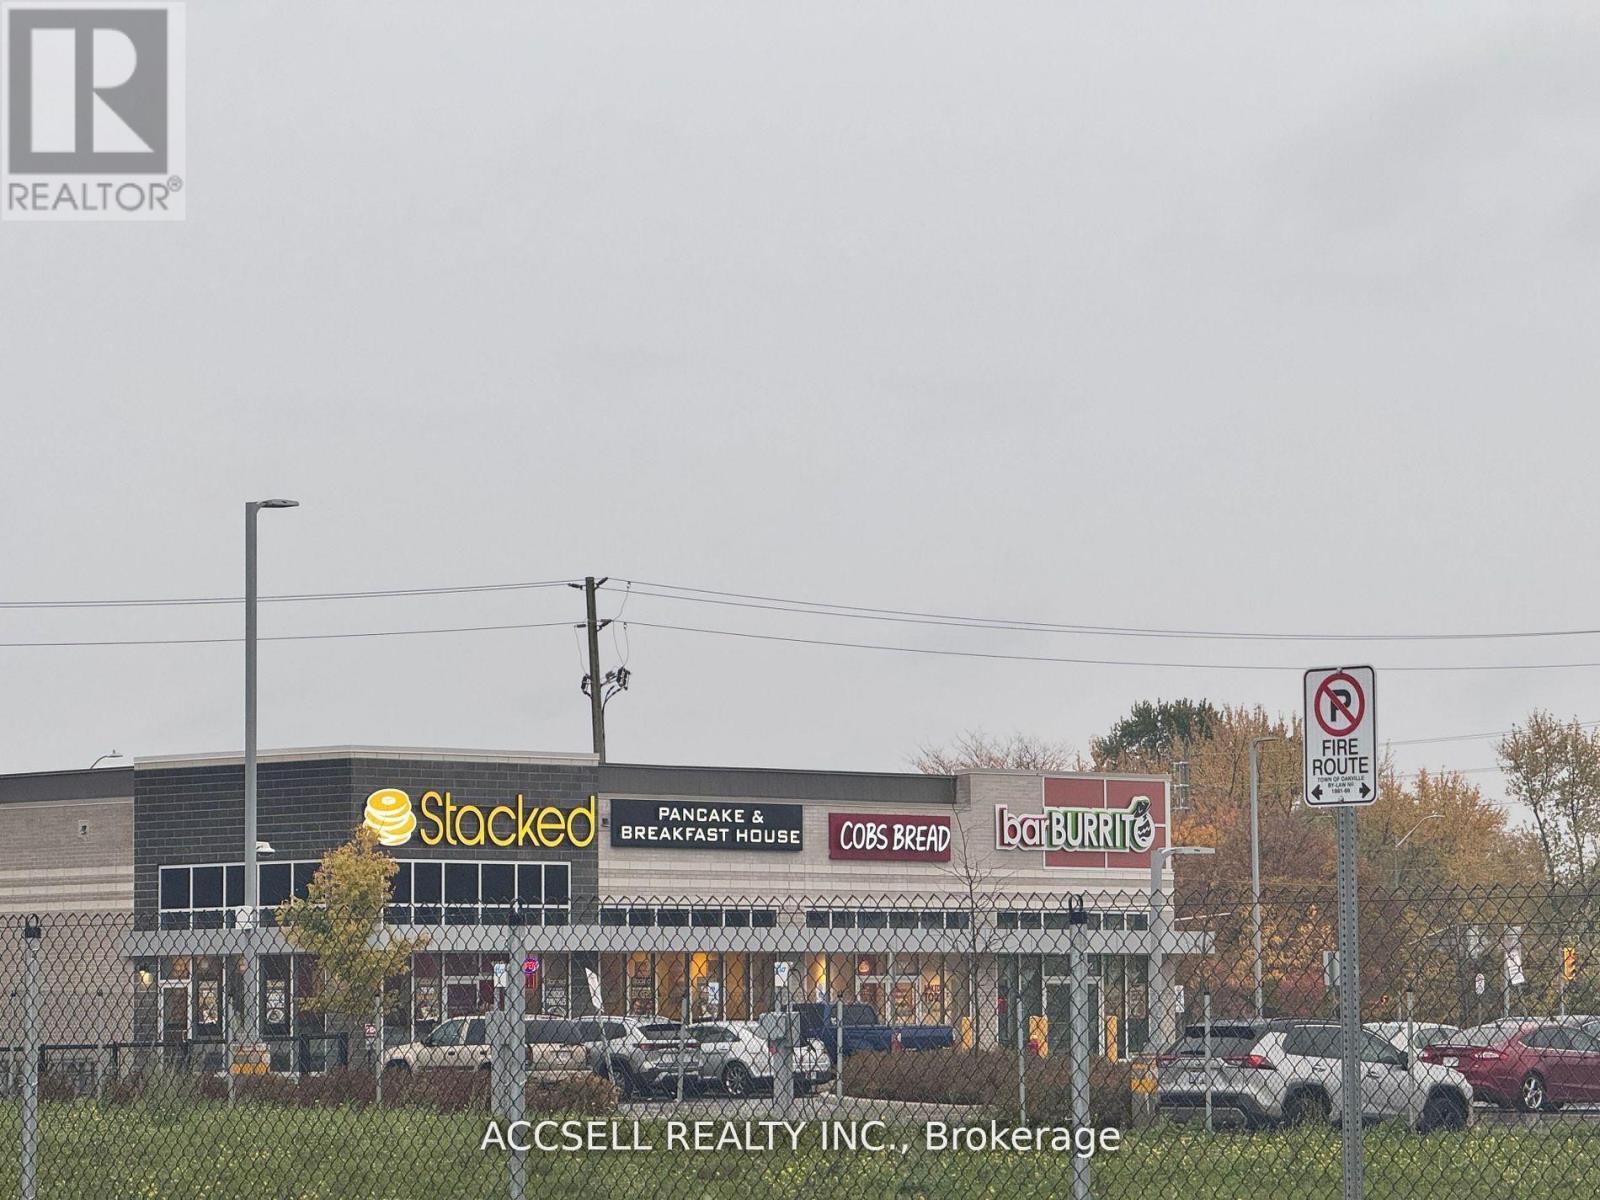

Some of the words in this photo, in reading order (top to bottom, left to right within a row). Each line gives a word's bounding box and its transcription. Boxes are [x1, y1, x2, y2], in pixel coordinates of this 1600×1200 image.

[1322, 738, 1358, 757] FIRE
[1312, 757, 1369, 776] ROUTE
[420, 791, 596, 847] Stacked
[658, 807, 745, 823] PANCAKE
[752, 810, 764, 824] &
[621, 825, 730, 842] BREAKFAST
[736, 828, 800, 844] HOUSE
[840, 821, 889, 851] COBS
[892, 823, 950, 852] BREAD
